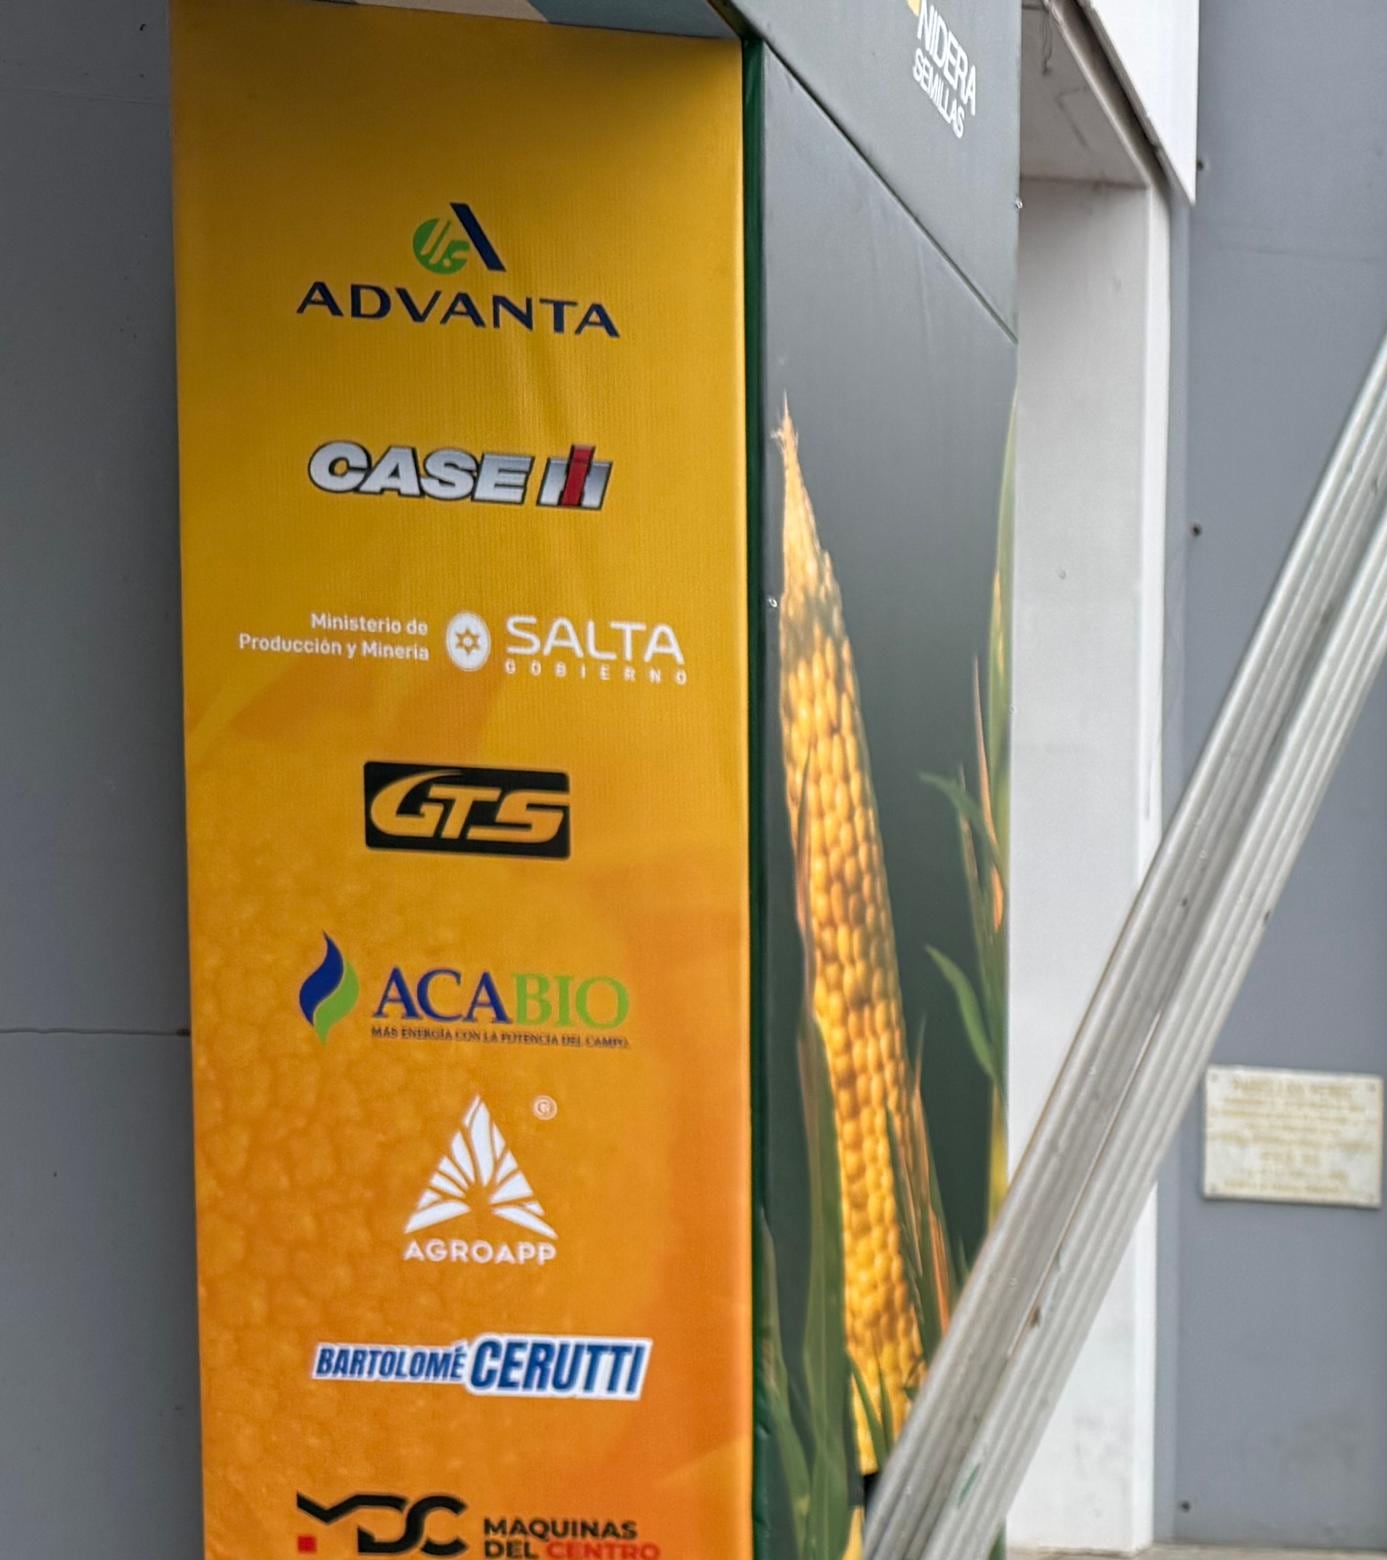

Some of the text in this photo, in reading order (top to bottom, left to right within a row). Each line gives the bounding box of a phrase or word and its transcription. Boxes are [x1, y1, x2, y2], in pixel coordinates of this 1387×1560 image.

[917, 0, 976, 116] NIDERA
[912, 47, 965, 139] SEMILLAS
[296, 281, 620, 338] ADVANTA
[308, 440, 534, 505] CASE
[239, 632, 342, 656] Producción
[346, 643, 357, 659] y
[311, 612, 428, 636] Ministerio de
[506, 615, 685, 664] SALTA
[504, 659, 687, 685] GOBIERNO
[370, 769, 570, 843] GTS
[372, 966, 630, 1031] ACABIO
[455, 1030, 481, 1043] CON
[483, 1032, 499, 1044] LA
[500, 1033, 559, 1046] POTENCIA
[561, 1035, 582, 1047] DEL
[403, 1238, 557, 1266] AGROAPP
[315, 1341, 646, 1394] BARTOLOMÉ CERUTTI
[483, 1517, 638, 1541] MAQUINAS
[483, 1540, 540, 1560] DEL
